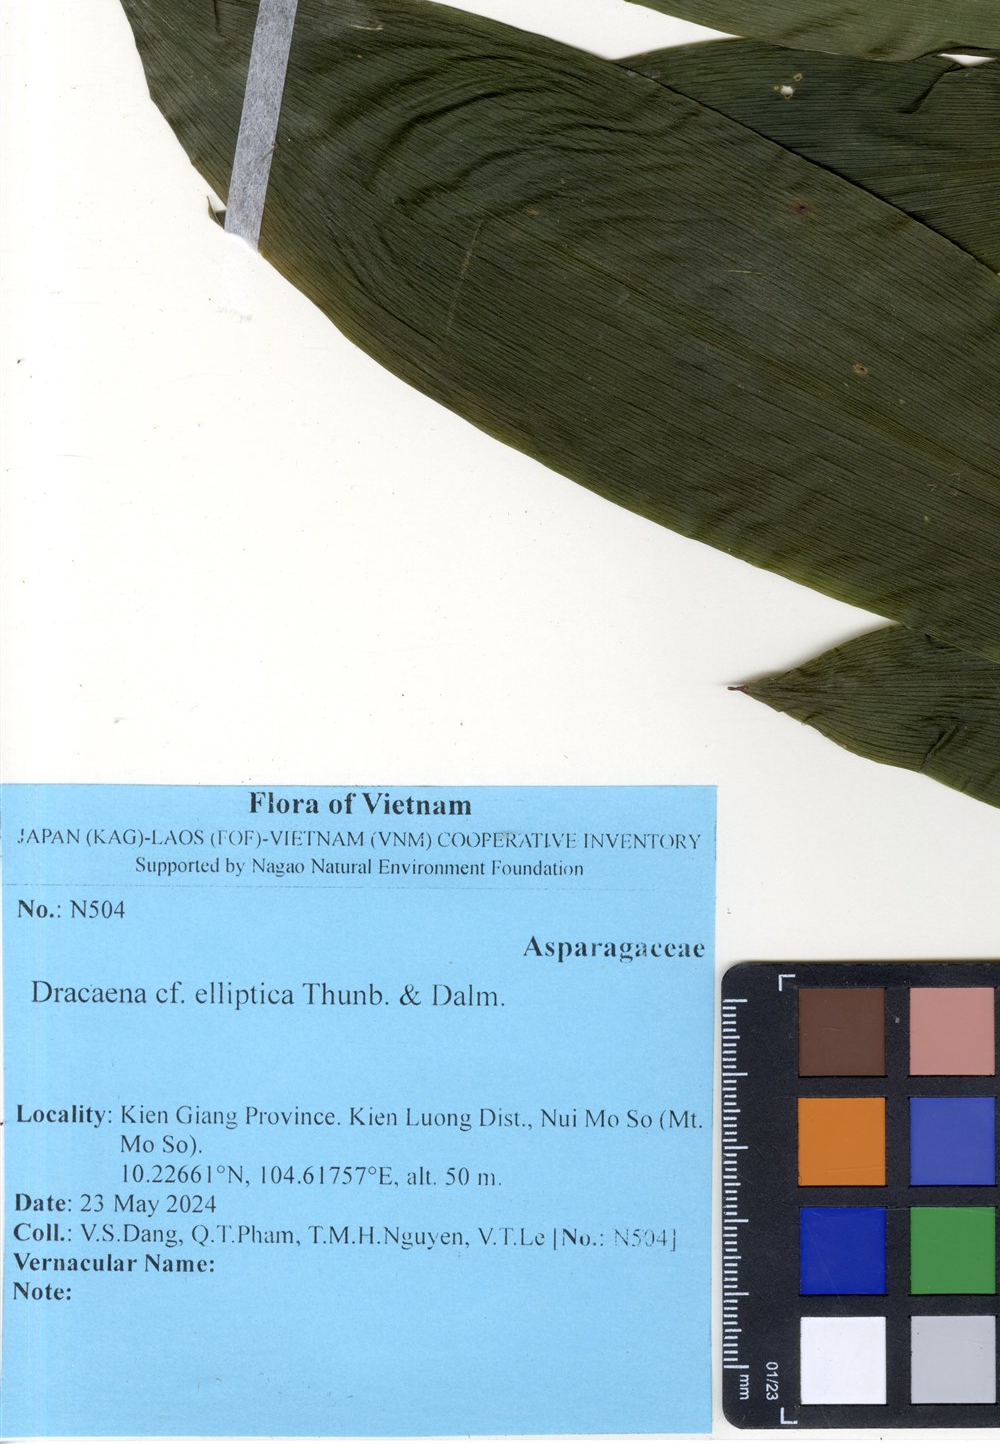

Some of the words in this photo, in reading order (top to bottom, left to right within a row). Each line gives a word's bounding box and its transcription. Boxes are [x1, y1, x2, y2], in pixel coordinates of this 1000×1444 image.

[249, 791, 320, 815] Flora
[328, 792, 357, 815] of
[361, 792, 472, 816] Vietnam
[17, 828, 80, 845] JAPAN
[86, 828, 204, 848] (KAG)-LAOS
[210, 830, 364, 849] (FOF)-VIETNAM
[370, 831, 432, 851] (VNM)
[437, 831, 576, 849] COOPERATIVE
[584, 832, 701, 850] INVENTORY
[135, 856, 220, 877] Supported
[225, 857, 246, 877] by
[252, 858, 305, 878] Nagao
[311, 858, 372, 875] Natural
[378, 858, 485, 876] Environment
[491, 859, 584, 876] Foundation
[17, 899, 61, 919] No.:
[69, 899, 126, 919] N504
[523, 935, 706, 964] Asparagaceae
[31, 980, 147, 1004] Dracaena
[155, 980, 185, 1004] cf.
[195, 981, 295, 1011] elliptica
[302, 982, 389, 1006] Thunb.
[399, 984, 422, 1006] &
[432, 984, 505, 1007] Dalm.
[16, 1104, 112, 1129] Locality:
[121, 1104, 169, 1124] Kien
[175, 1105, 238, 1130] Giang
[349, 1106, 398, 1126] Kien
[406, 1107, 473, 1133] Luong
[479, 1108, 533, 1131] Dist.,
[540, 1108, 577, 1128] Nui
[585, 1109, 620, 1128] Mo
[626, 1109, 653, 1128] So
[659, 1109, 703, 1131] (Mt.
[120, 1134, 155, 1154] Mo
[162, 1134, 203, 1157] So).
[123, 1163, 250, 1188] 10.22661°N,
[261, 1165, 399, 1187] 104.61757°E,
[406, 1166, 438, 1186] alt.
[445, 1166, 470, 1186] 50
[477, 1172, 502, 1186] m.
[15, 1193, 72, 1213] Date:
[80, 1193, 104, 1213] 23
[114, 1193, 160, 1218] May
[166, 1194, 217, 1214] 2024
[13, 1222, 72, 1242] Coll.:
[80, 1223, 184, 1249] V.S.Dang,
[191, 1224, 301, 1247] Q.T.Pham,
[307, 1225, 470, 1251] T.M.H.Nguyen,
[477, 1227, 545, 1247] V.T.Le
[13, 1252, 138, 1272] Vernacular
[144, 1253, 215, 1273] Name:
[12, 1281, 72, 1301] Note:
[739, 1374, 750, 1400] mm
[765, 1361, 779, 1401] 01/23
